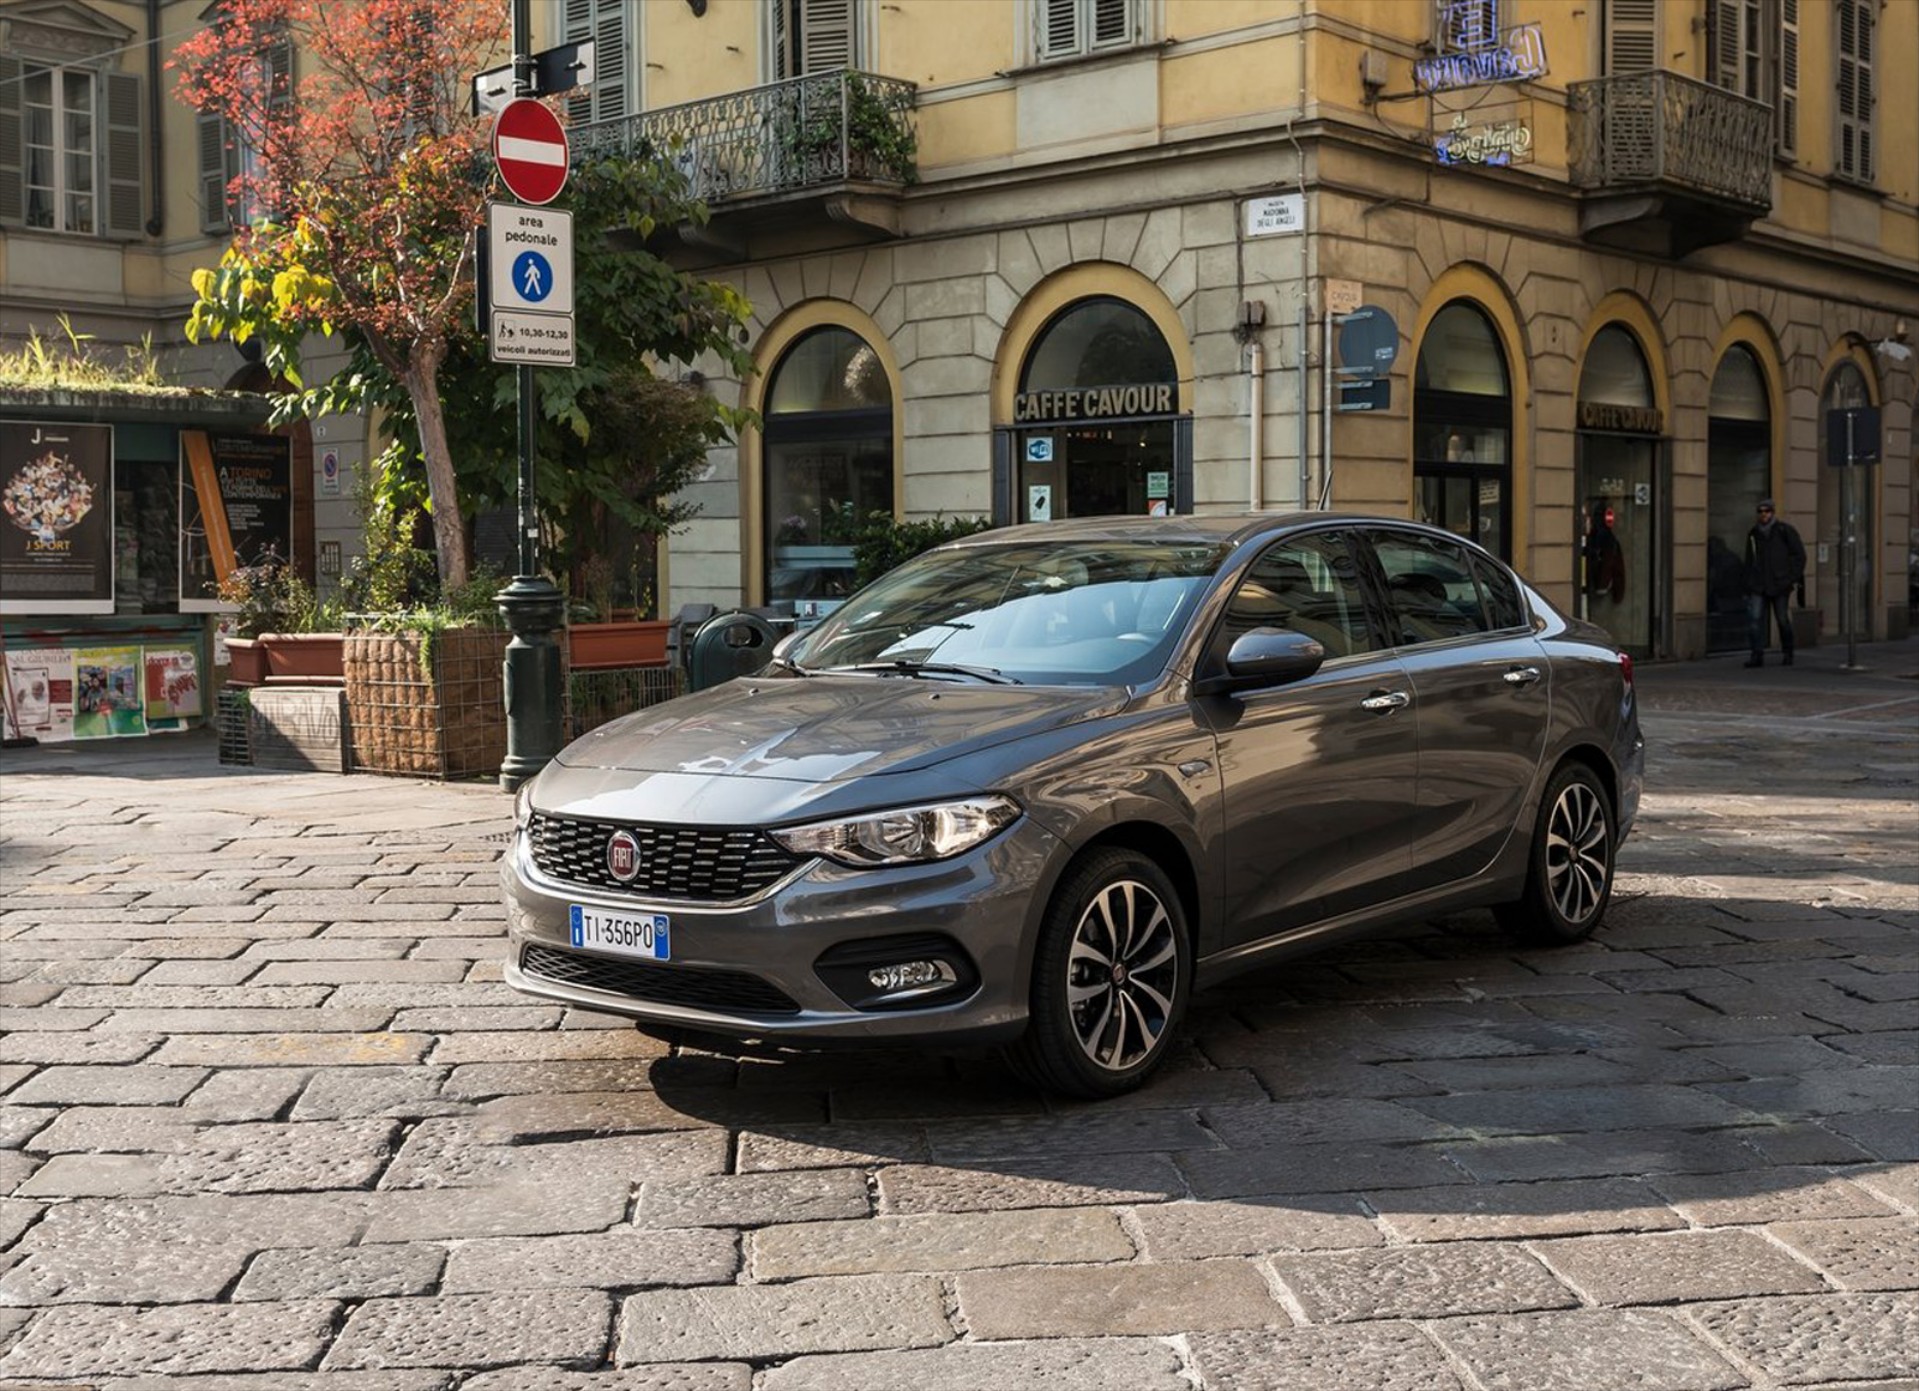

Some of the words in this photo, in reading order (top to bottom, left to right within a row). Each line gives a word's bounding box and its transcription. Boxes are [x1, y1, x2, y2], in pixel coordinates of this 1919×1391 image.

[519, 216, 543, 228] area
[505, 231, 558, 247] pedonale
[519, 327, 568, 339] 10,30-12,30
[497, 345, 525, 355] veicoli
[528, 346, 571, 357] autorizzati
[1083, 384, 1171, 417] CAVOUR
[34, 539, 71, 551] SPORT
[613, 847, 633, 869] FIAT
